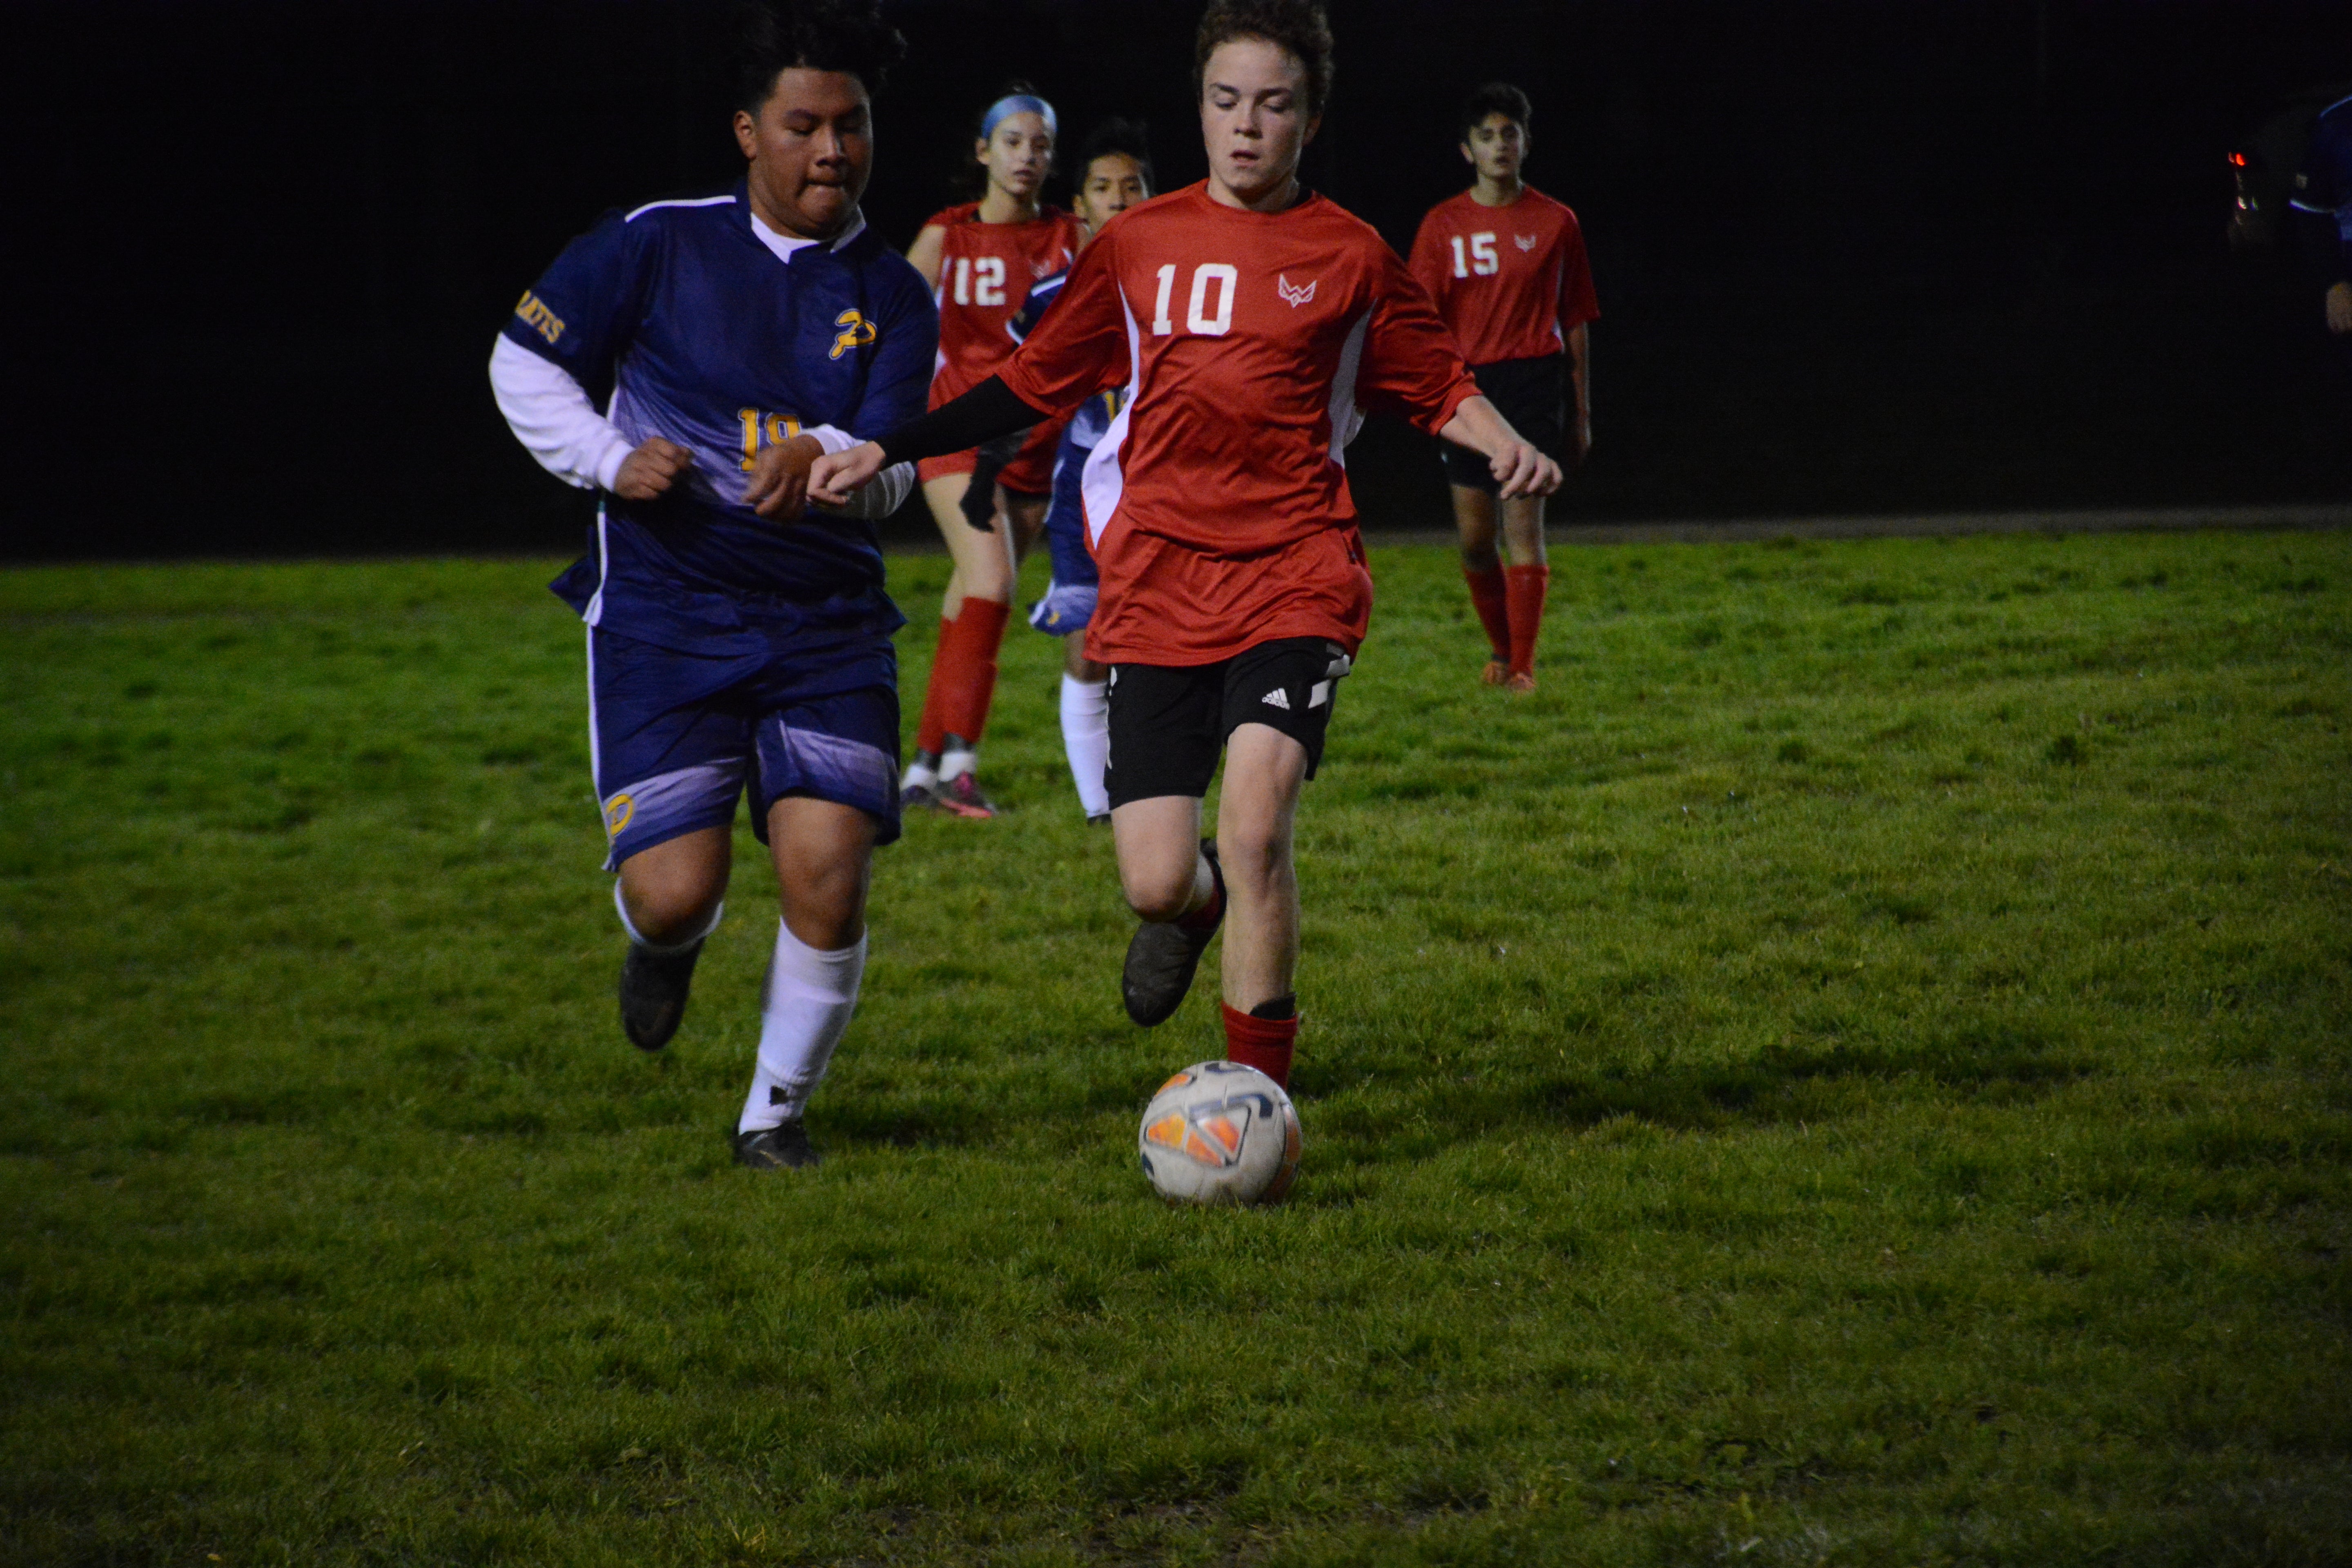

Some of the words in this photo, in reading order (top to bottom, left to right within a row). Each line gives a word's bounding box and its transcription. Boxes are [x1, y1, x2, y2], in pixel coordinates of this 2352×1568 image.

[1451, 231, 1499, 278] 15
[954, 256, 1006, 306] 12
[1152, 263, 1238, 336] 10
